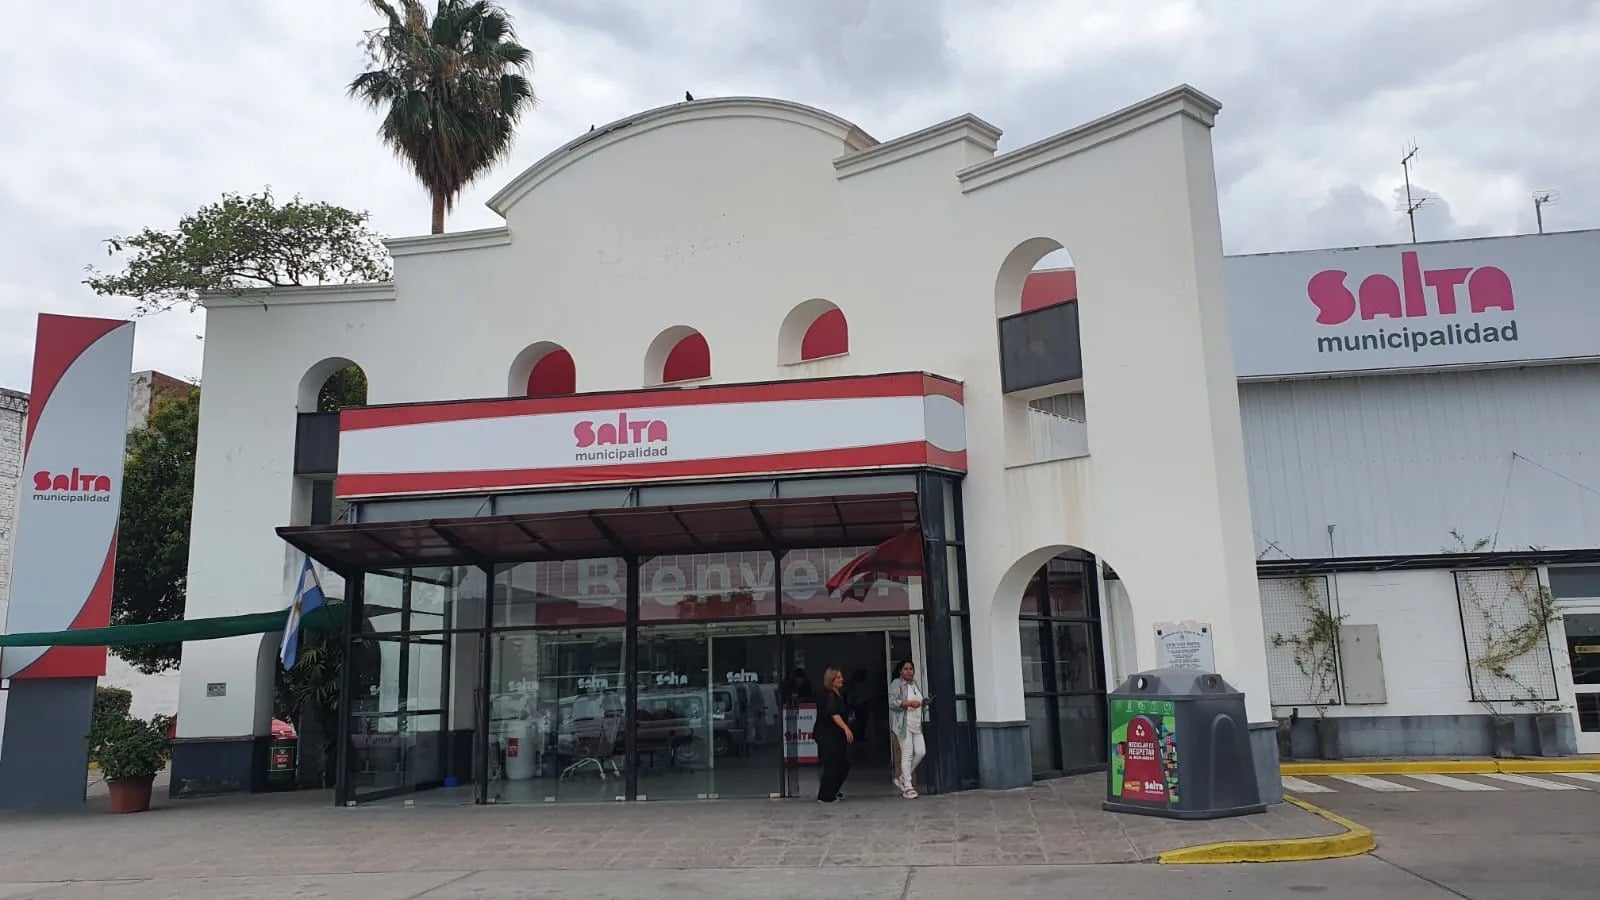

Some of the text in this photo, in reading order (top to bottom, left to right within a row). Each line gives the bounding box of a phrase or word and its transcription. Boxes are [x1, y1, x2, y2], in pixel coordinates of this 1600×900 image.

[1317, 319, 1518, 352] municipalidad
[575, 446, 668, 461] municipalidad
[33, 493, 110, 503] municipalidad
